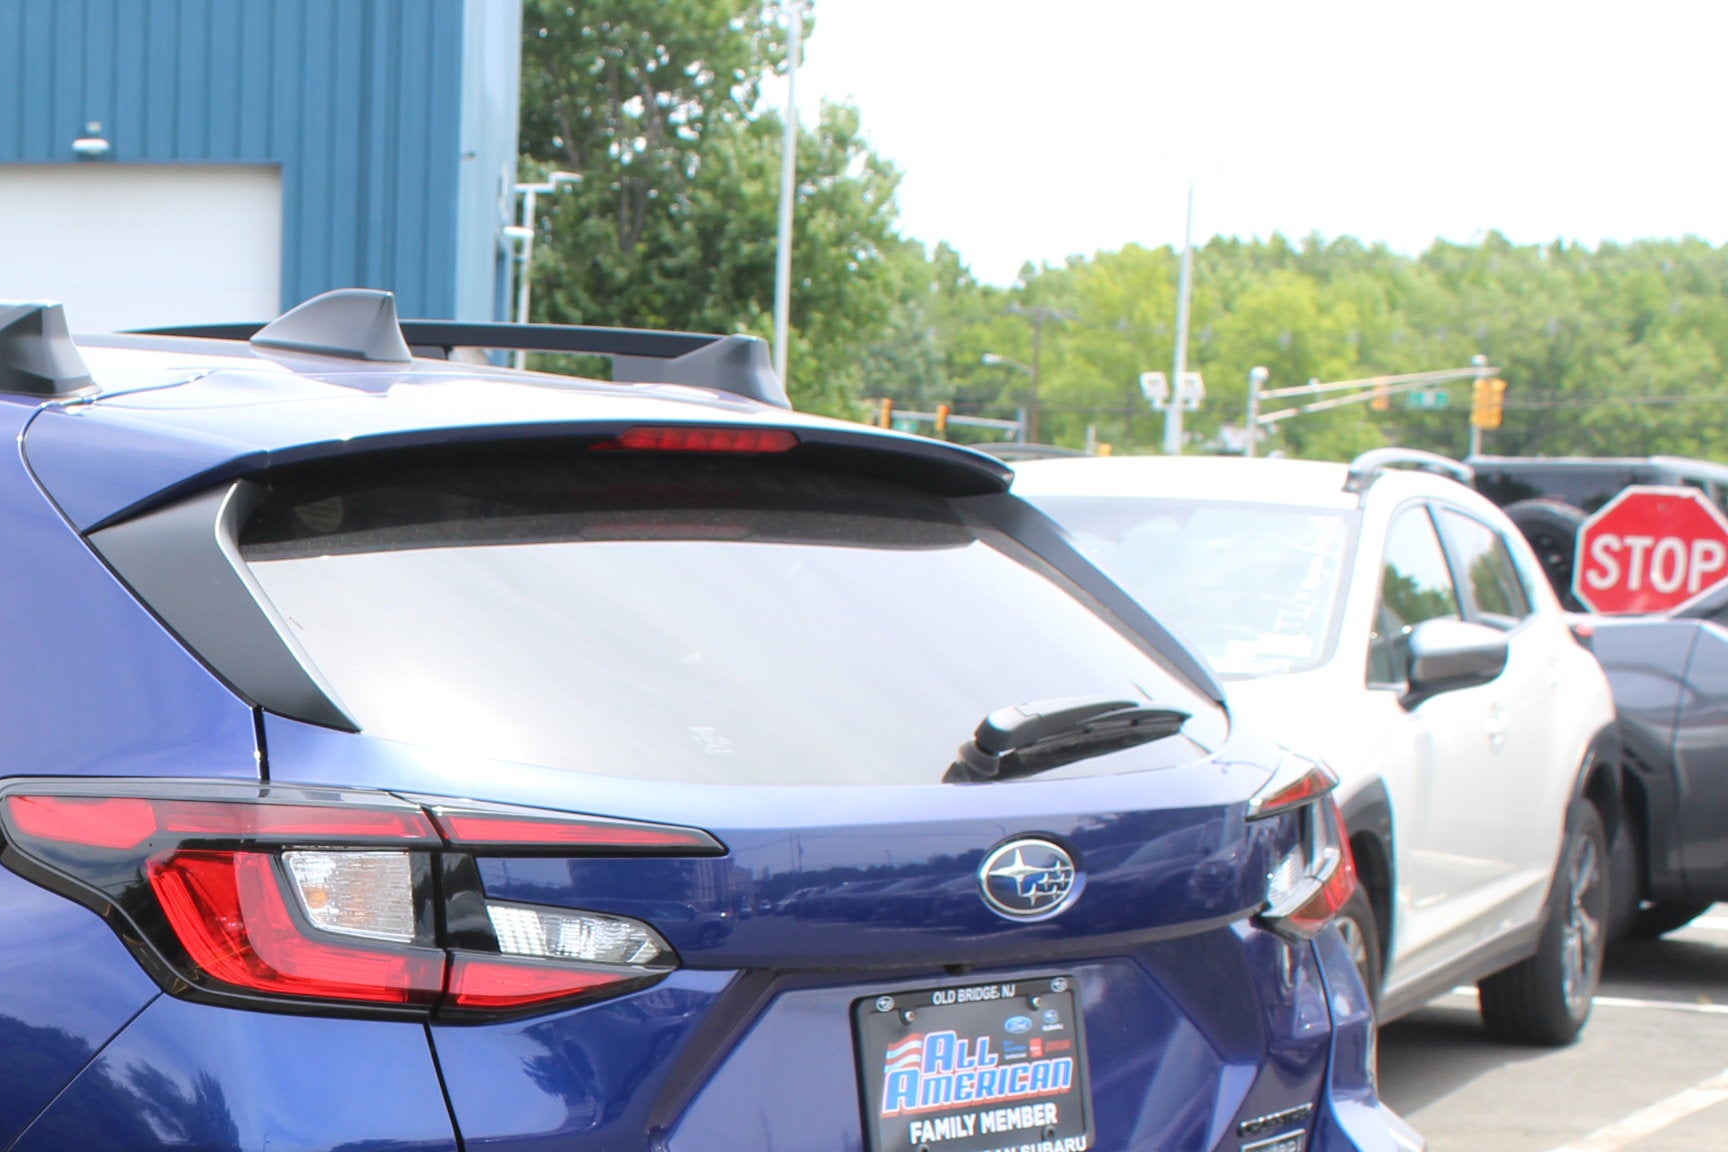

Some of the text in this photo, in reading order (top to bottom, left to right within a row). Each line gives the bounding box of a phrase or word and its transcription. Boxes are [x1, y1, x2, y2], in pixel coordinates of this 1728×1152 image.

[1585, 533, 1726, 594] STOP
[932, 990, 956, 1006] OLD
[1001, 983, 1016, 998] NJ
[909, 1102, 1058, 1145] FAMILY MEMBER
